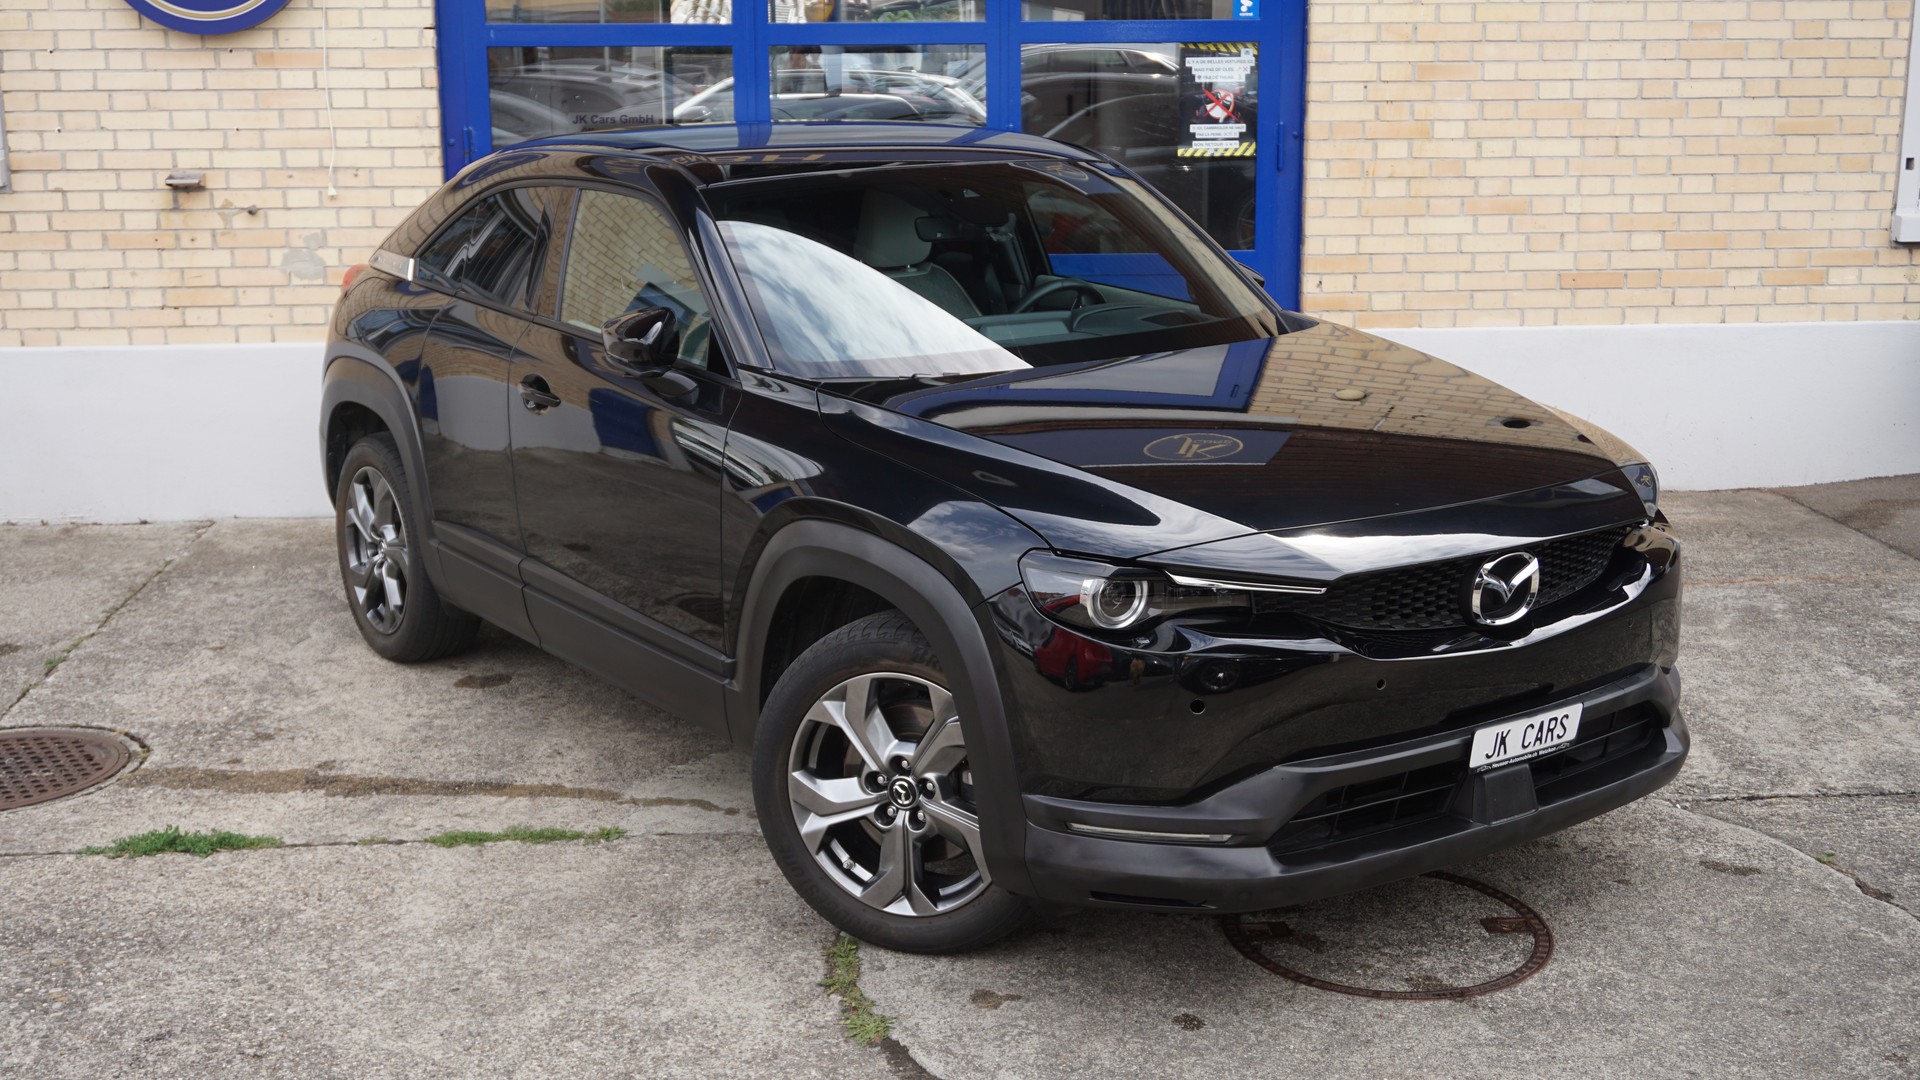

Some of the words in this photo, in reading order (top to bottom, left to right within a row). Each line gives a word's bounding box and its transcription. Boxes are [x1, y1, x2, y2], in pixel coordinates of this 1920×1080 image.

[572, 114, 588, 124] JK
[590, 114, 616, 124] Cars
[620, 114, 654, 124] GmbH
[1485, 728, 1511, 759] JK
[1521, 713, 1569, 750] CARS
